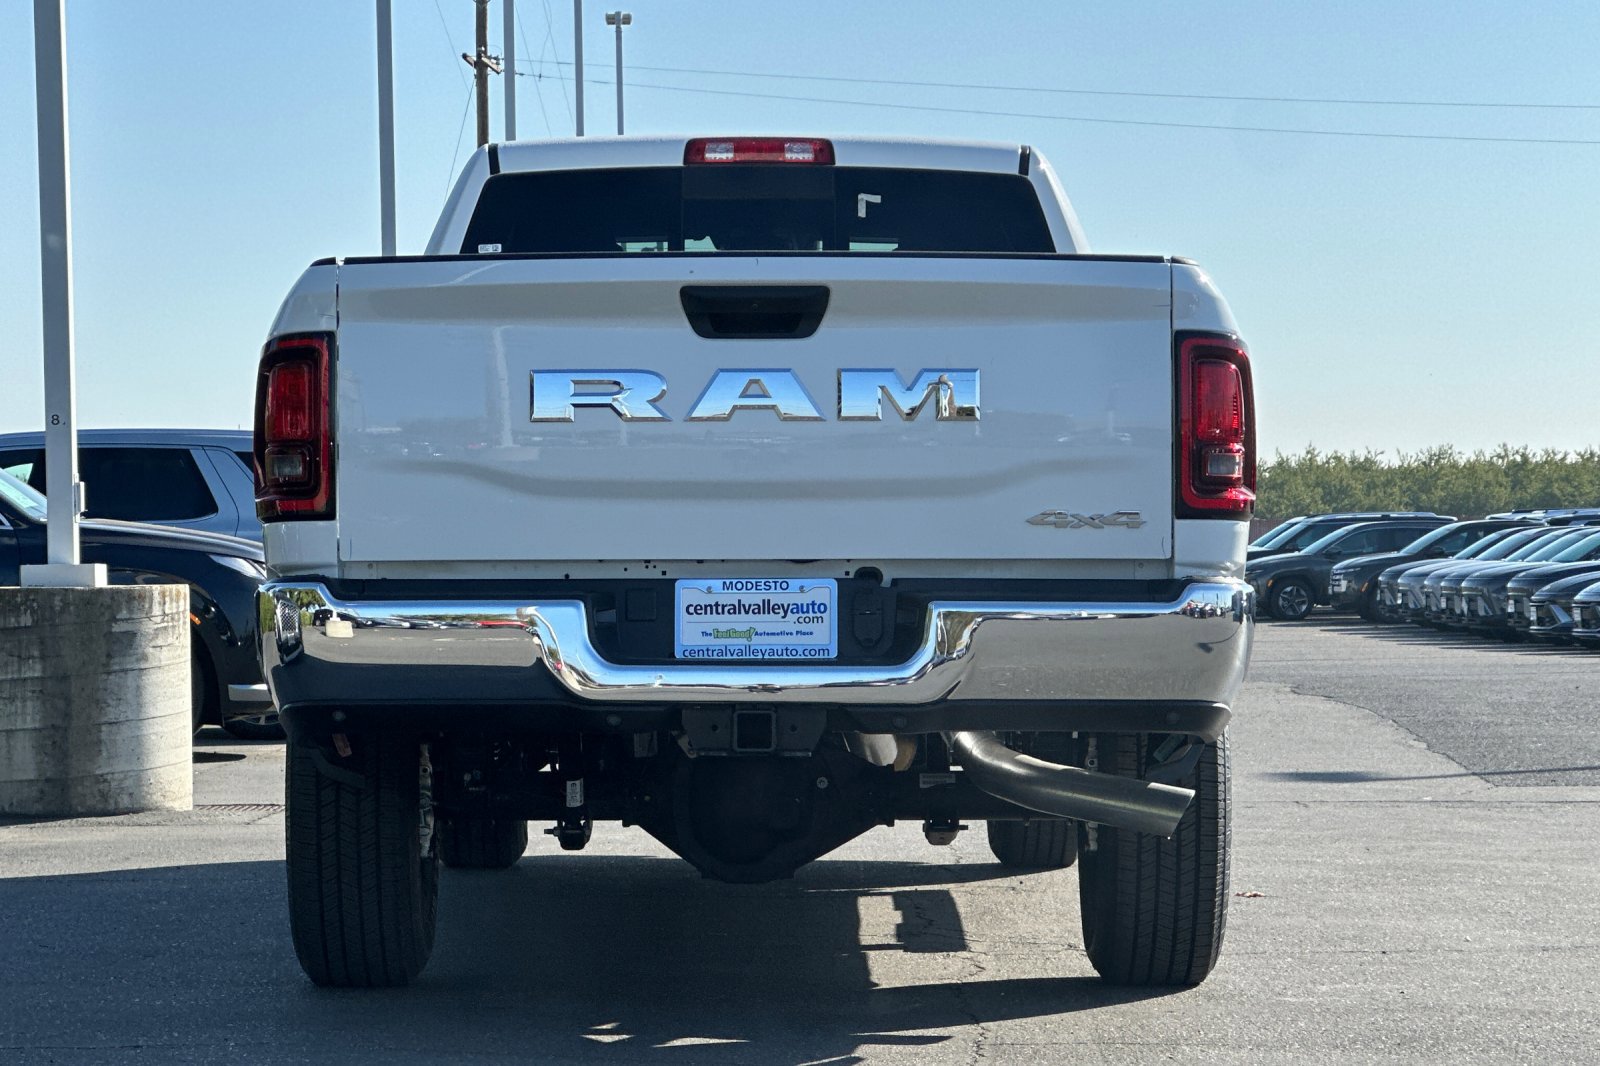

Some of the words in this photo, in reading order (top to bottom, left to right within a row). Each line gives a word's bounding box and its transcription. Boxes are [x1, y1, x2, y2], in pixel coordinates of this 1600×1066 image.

[530, 368, 981, 422] RAM
[51, 414, 60, 426] 8
[722, 580, 790, 591] MODESTO
[685, 599, 828, 619] centralvalleyauto
[793, 615, 824, 624] .com
[682, 645, 830, 659] centralvalleyauto.com
